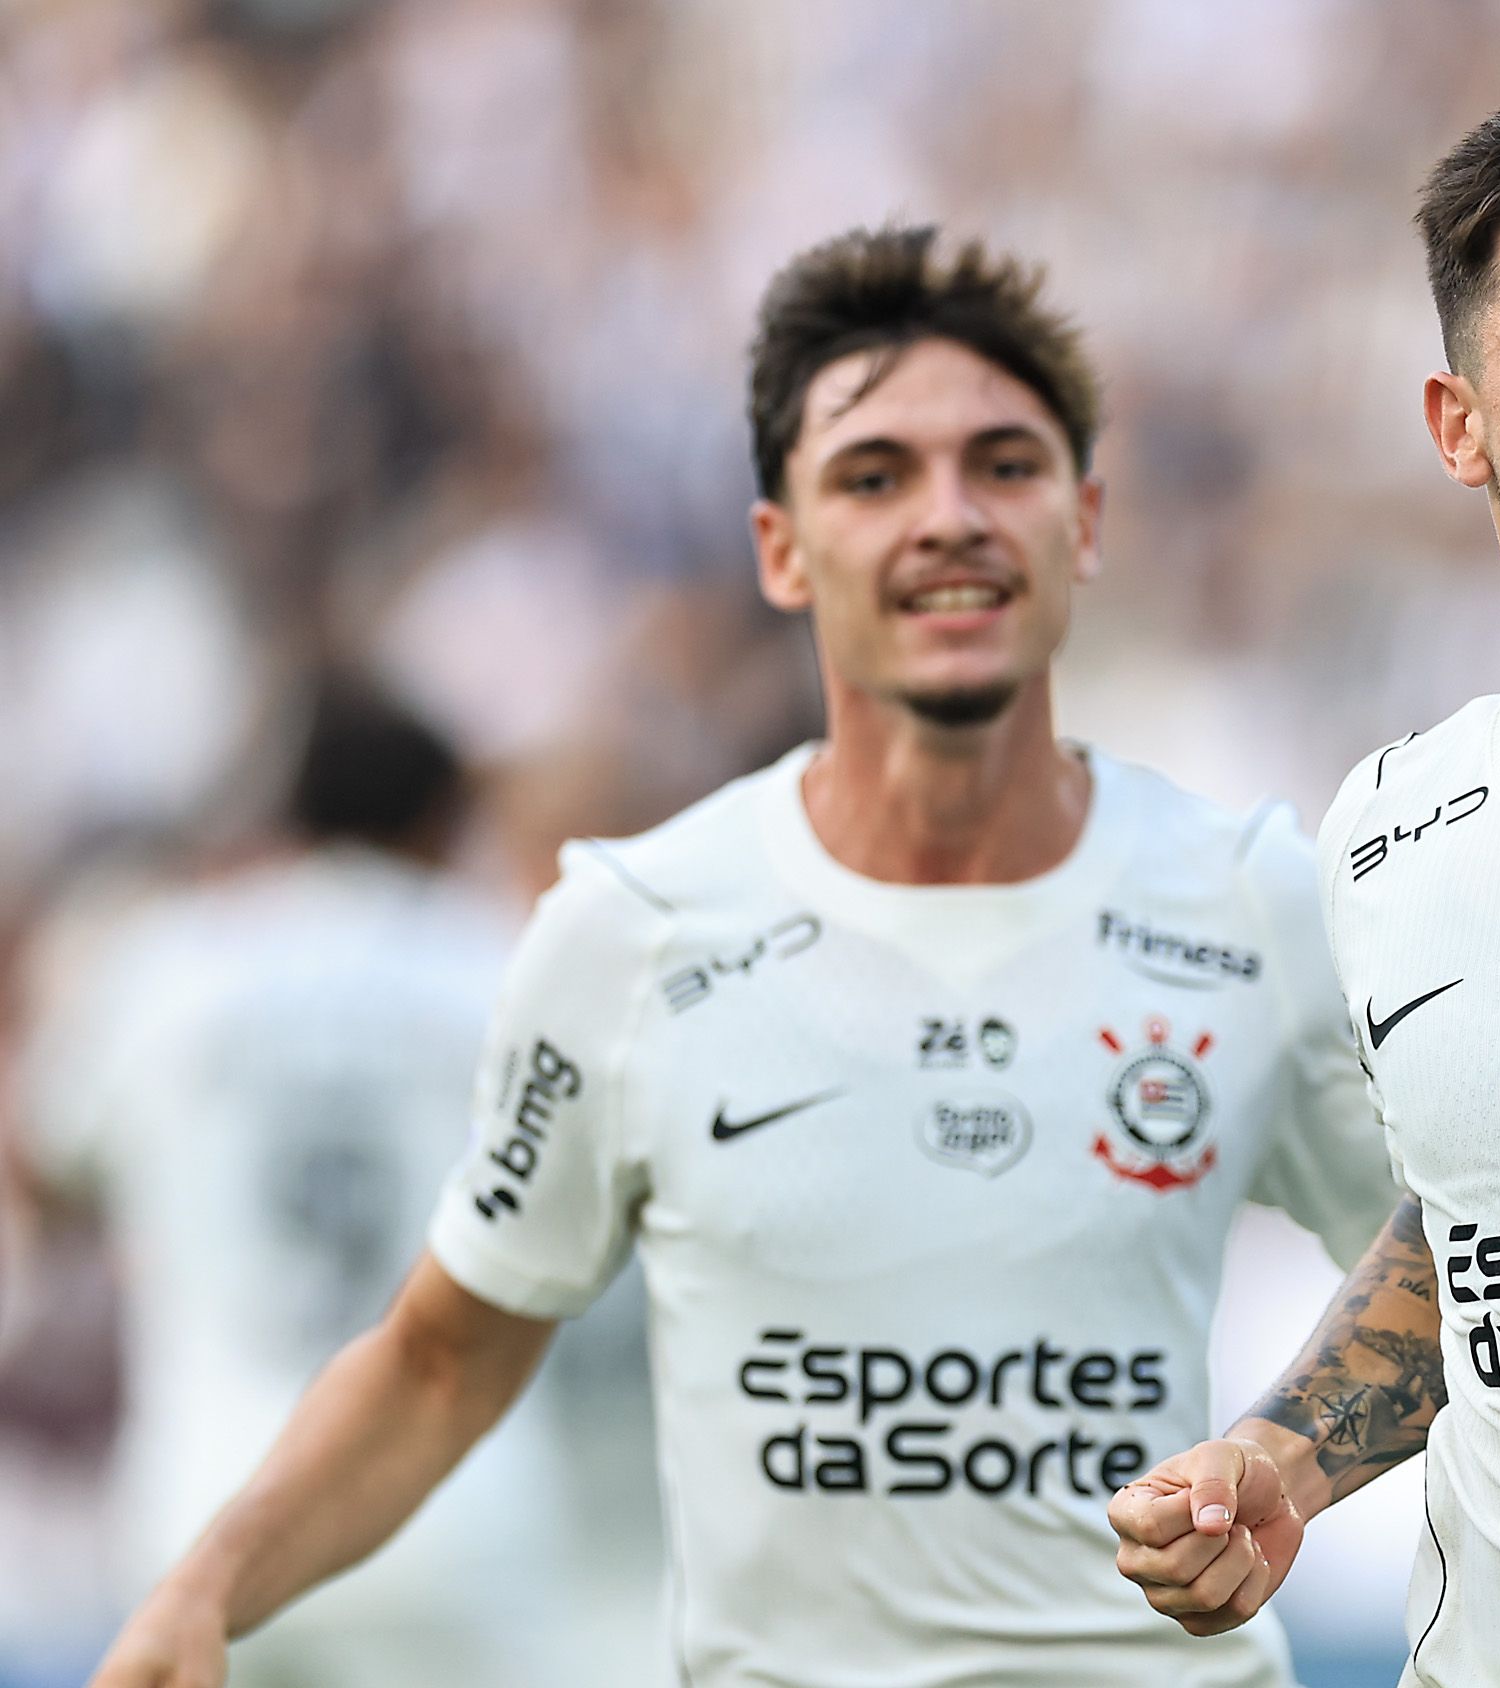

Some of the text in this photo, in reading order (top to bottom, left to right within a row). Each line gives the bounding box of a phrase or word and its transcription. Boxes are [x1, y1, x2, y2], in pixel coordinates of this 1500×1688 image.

[1351, 786, 1489, 882] BYD
[489, 1039, 582, 1180] bmg
[740, 1329, 1168, 1425] Esportes
